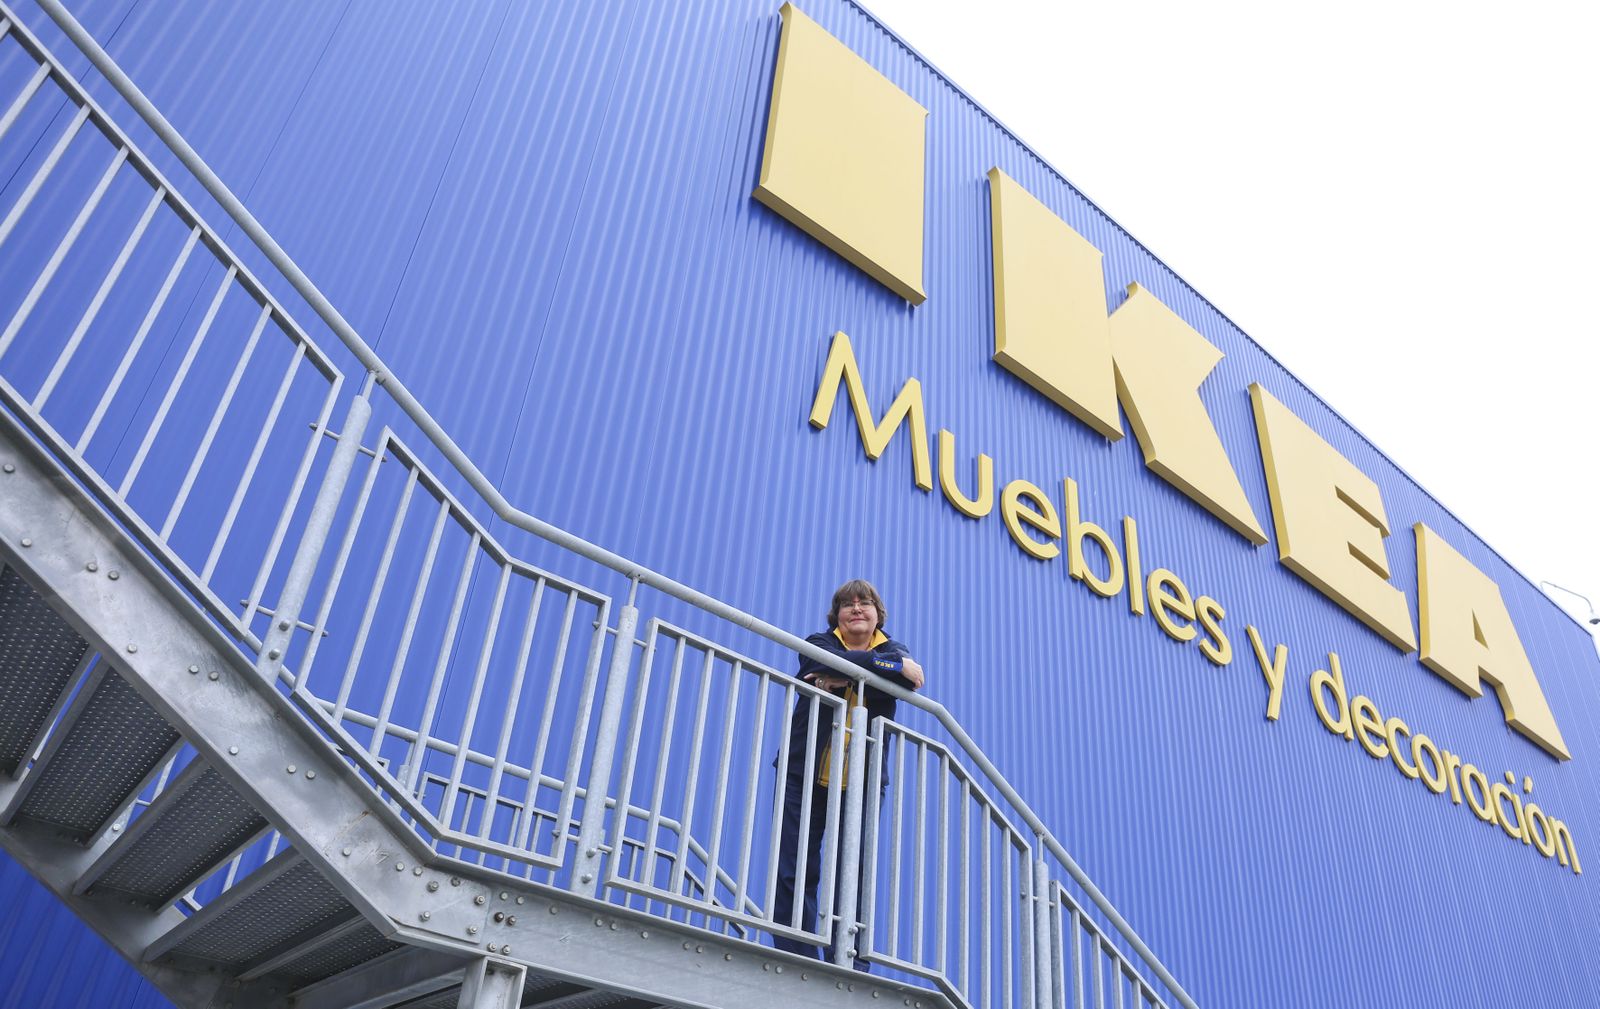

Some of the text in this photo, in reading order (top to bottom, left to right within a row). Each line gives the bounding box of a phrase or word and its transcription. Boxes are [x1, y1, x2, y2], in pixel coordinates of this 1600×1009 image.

[752, 3, 1570, 761] IKEA
[809, 331, 1582, 875] Muebles y decoración
